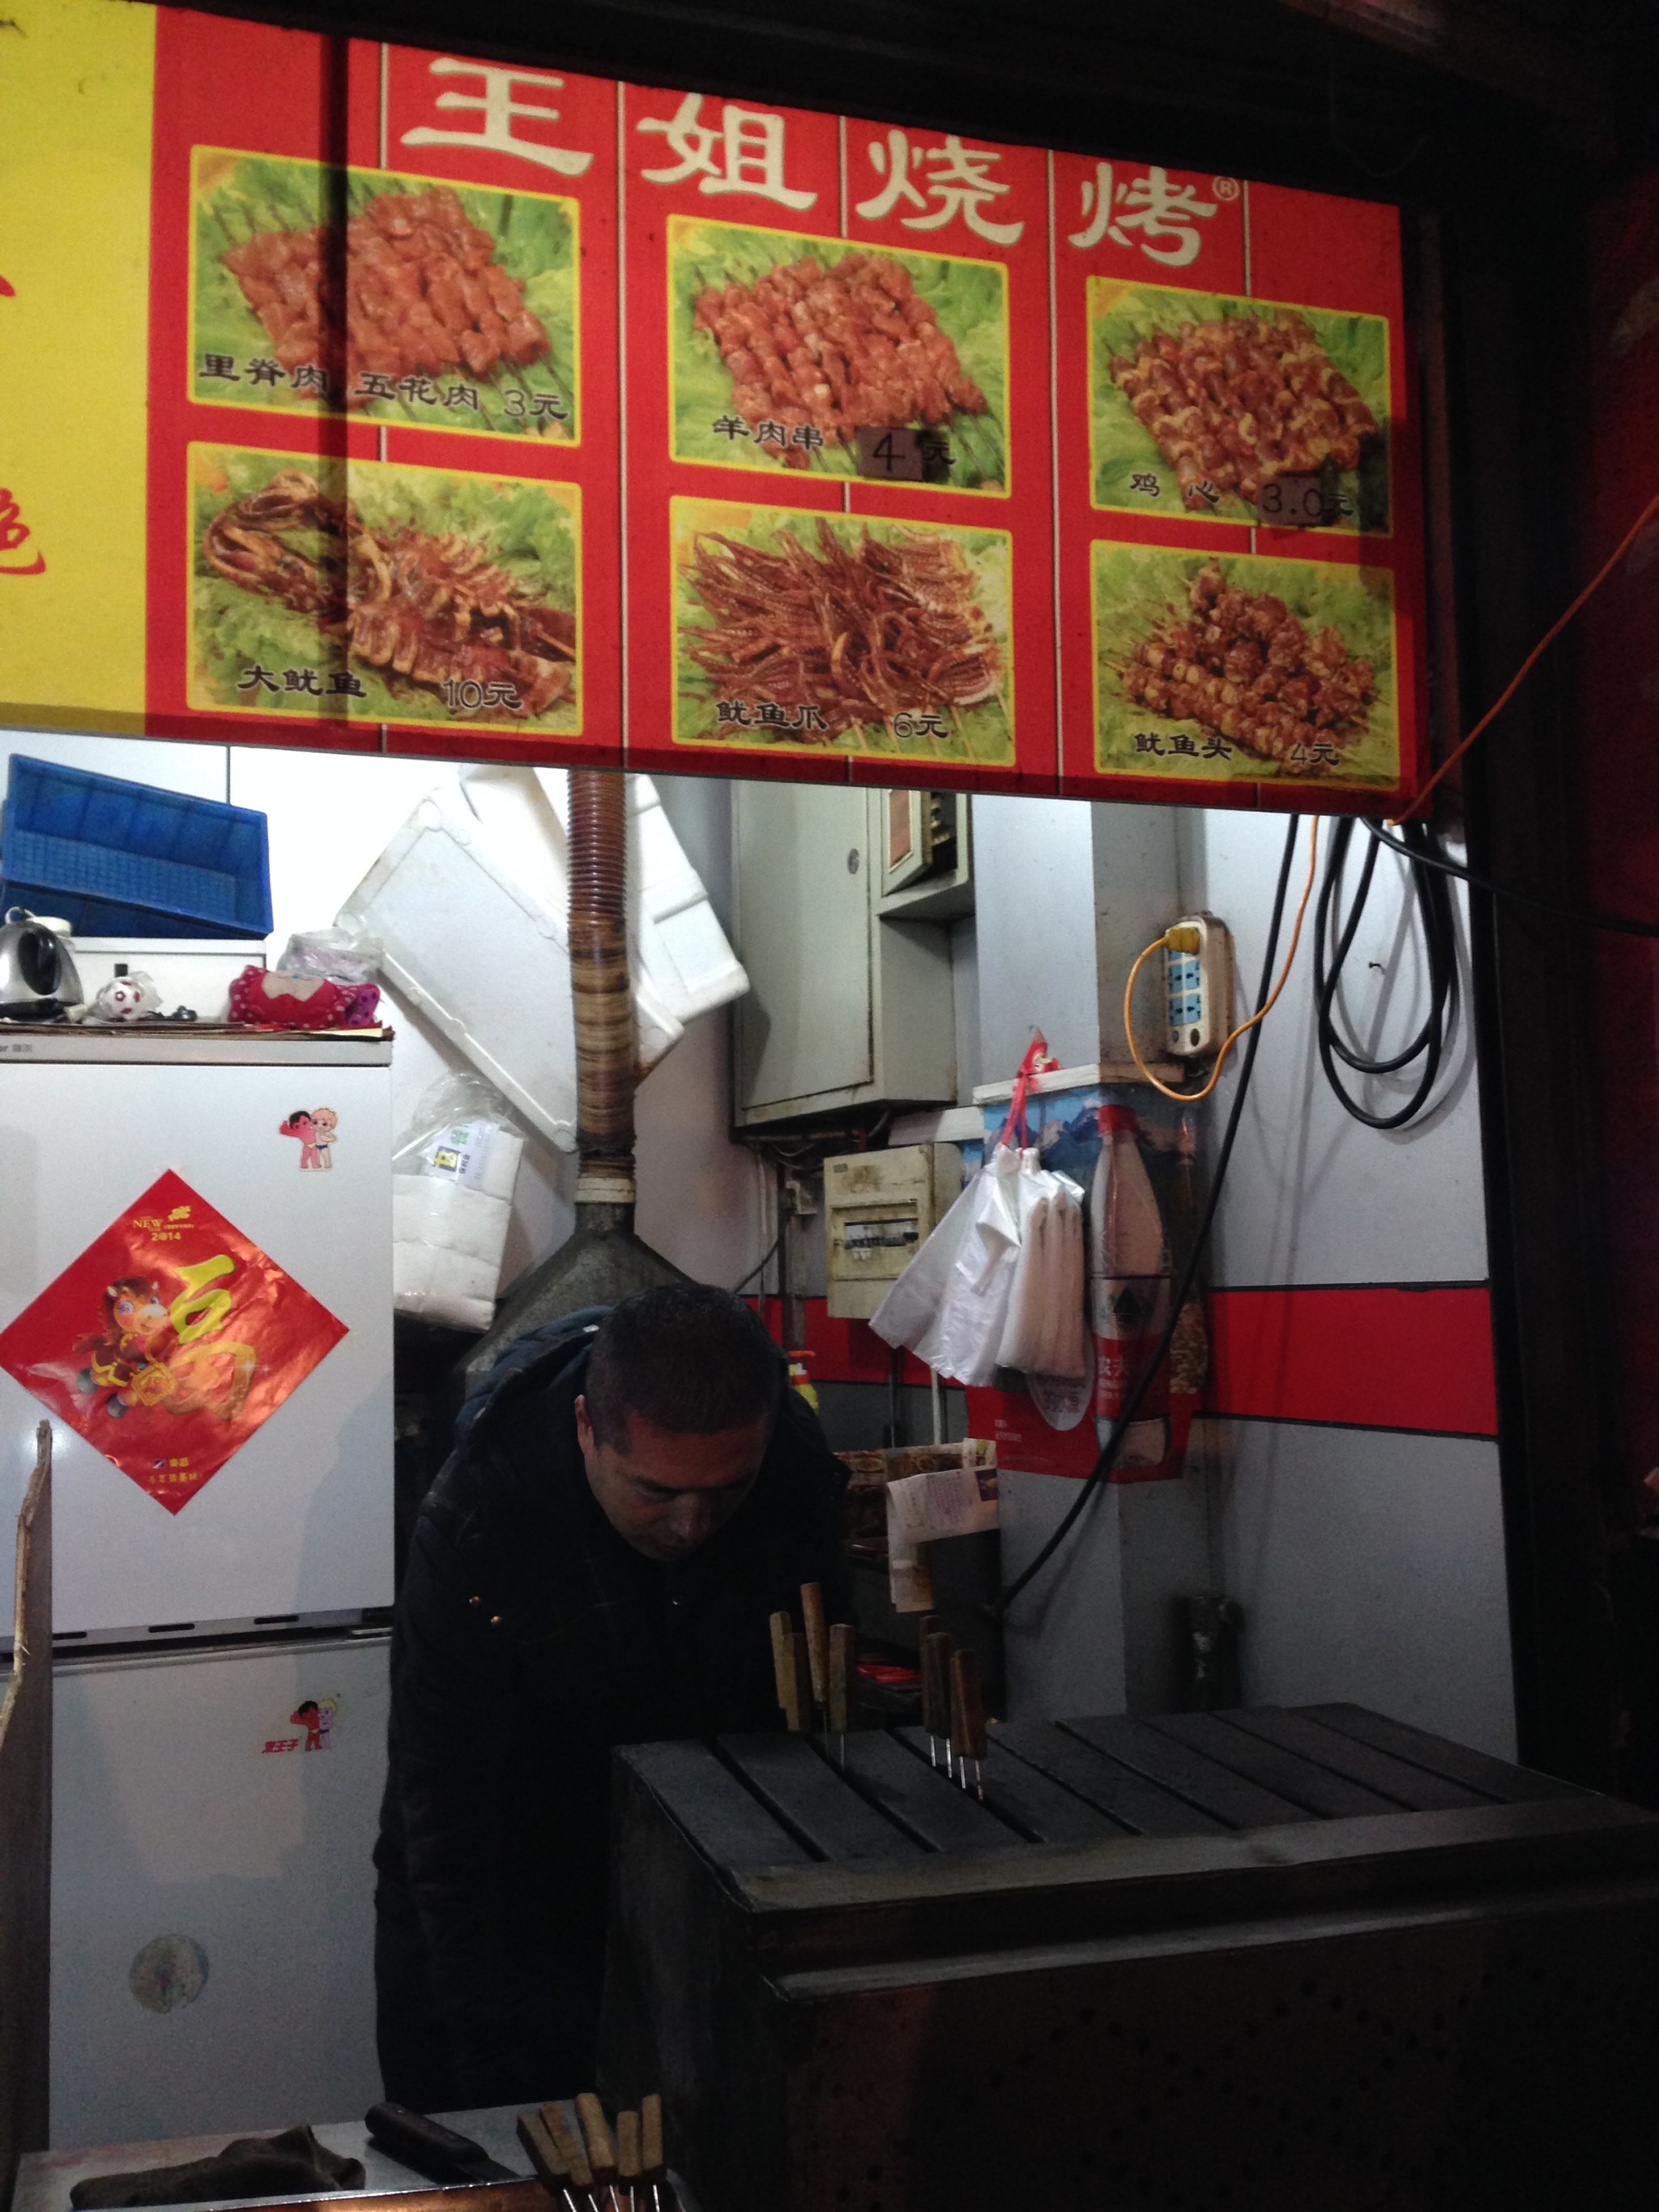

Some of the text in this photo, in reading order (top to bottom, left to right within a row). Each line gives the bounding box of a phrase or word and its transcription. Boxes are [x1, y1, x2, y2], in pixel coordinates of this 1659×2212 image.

[400, 57, 1218, 267] 王姐烧烤
[198, 353, 568, 421] 里脊肉 五花肉 3元
[712, 415, 825, 451] 羊肉串
[1129, 472, 1219, 503] 鸡心
[237, 664, 524, 710] 大鱿鱼 10元
[716, 699, 949, 740] 鱿鱼爪 6元
[1134, 732, 1341, 767] 鱿鱼头 4元
